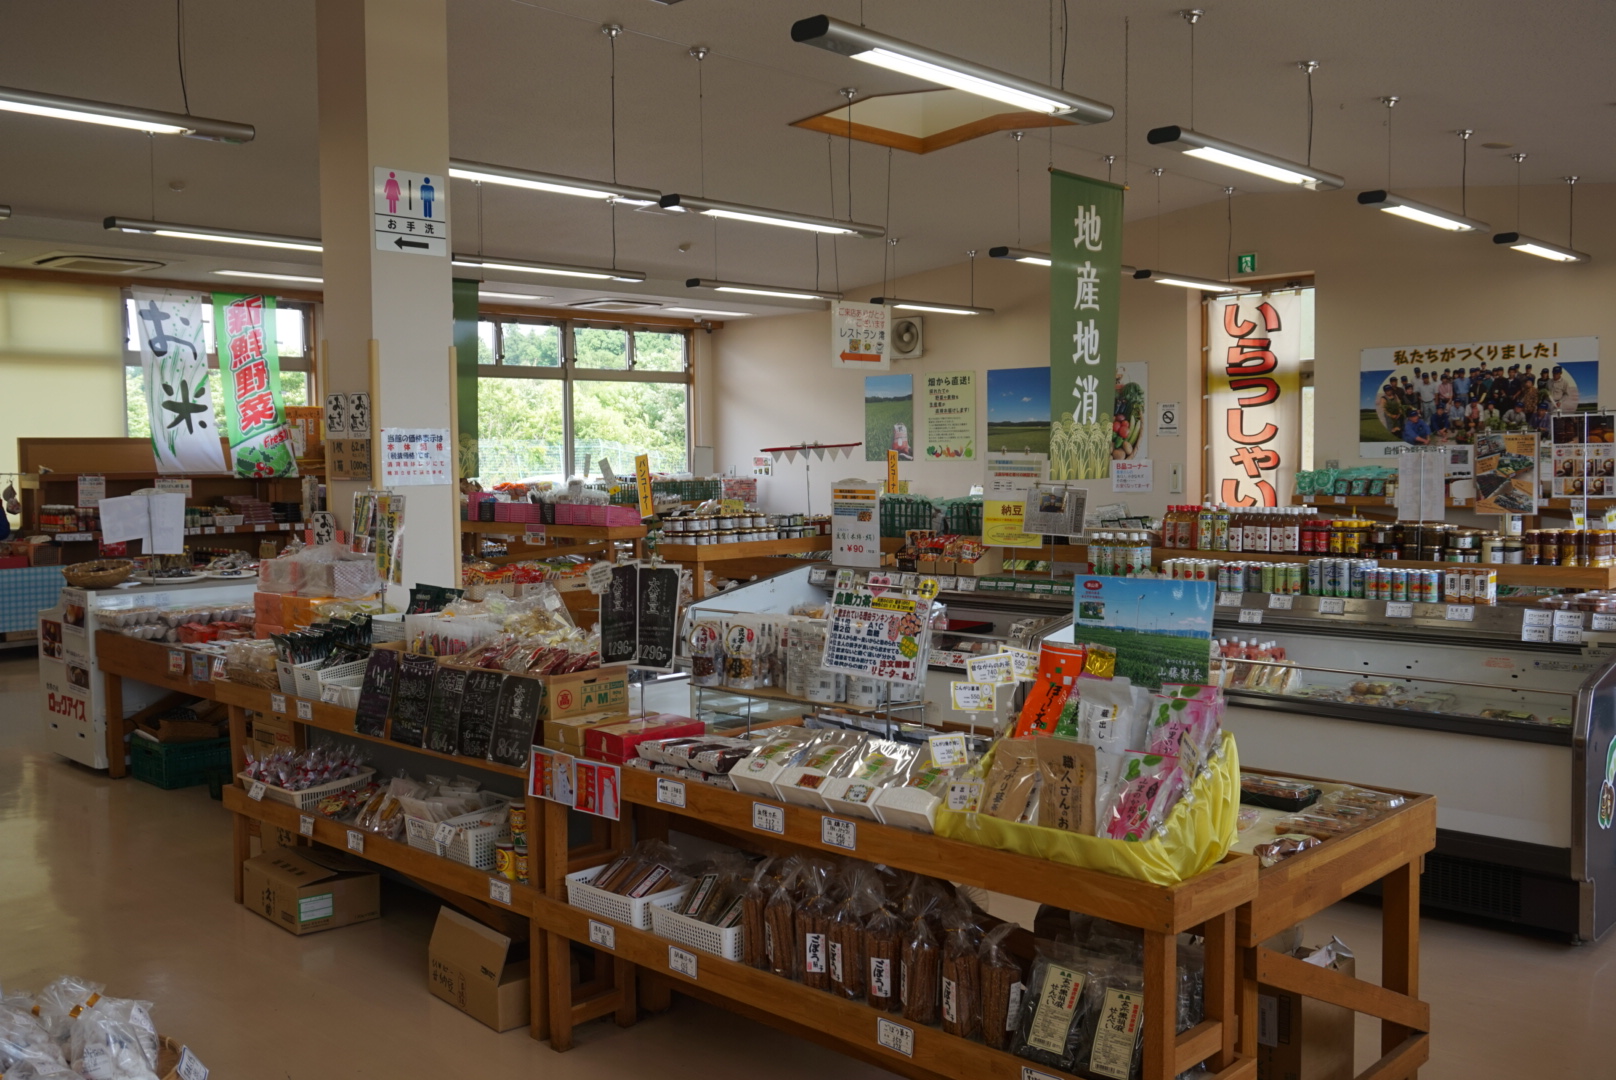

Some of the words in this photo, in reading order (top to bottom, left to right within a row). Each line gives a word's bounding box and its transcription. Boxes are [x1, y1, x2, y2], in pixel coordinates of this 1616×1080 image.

[387, 218, 435, 235] お手洗
[838, 307, 886, 320] ご来店ありがとう
[1072, 204, 1103, 426] 地産地消
[855, 318, 886, 329] ございます
[840, 328, 877, 340] レストラン
[1393, 342, 1559, 365] 私たちがつくりました!
[139, 299, 208, 435] お米
[227, 295, 277, 432] 新鮮野菜
[927, 376, 971, 386] 畑から直送!
[387, 434, 444, 443] 当館の価格表示は
[387, 443, 444, 451] 本体価格
[639, 459, 649, 510] パンコーナー
[1001, 504, 1023, 516] 納豆
[847, 544, 864, 553] ¥90
[597, 692, 609, 704] M
[48, 692, 87, 722] ロックアイス
[1046, 983, 1061, 1005] せんべい
[1105, 1007, 1119, 1029] せんべい
